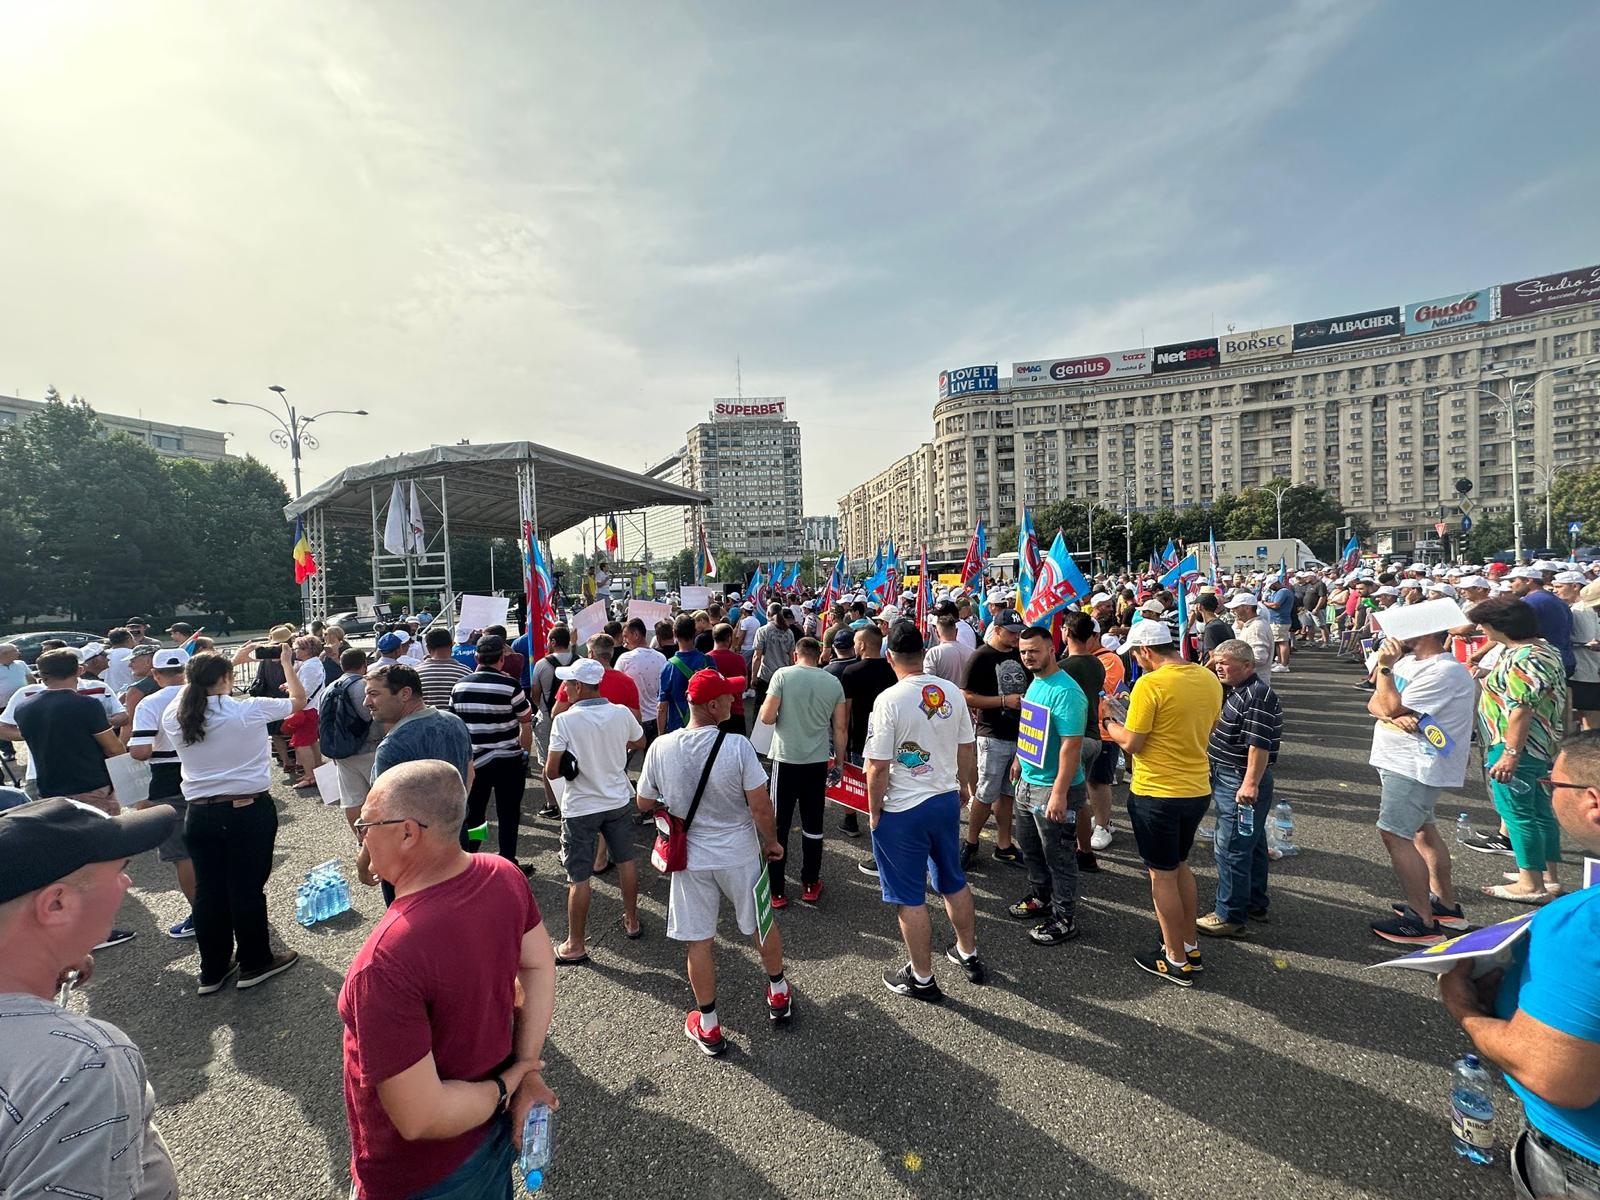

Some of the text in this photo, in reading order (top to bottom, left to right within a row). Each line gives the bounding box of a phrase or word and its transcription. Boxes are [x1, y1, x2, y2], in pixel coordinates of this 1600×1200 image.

[1515, 276, 1585, 297] Studio
[1415, 299, 1477, 322] Giusto
[1329, 314, 1395, 335] ALBACHER
[1226, 334, 1286, 354] BORSEC
[1121, 353, 1147, 361] tazz
[1157, 345, 1216, 365] NetBet
[950, 366, 997, 382] LOVE IT.
[1055, 360, 1104, 379] genius
[951, 378, 993, 394] LIVE IT.
[715, 402, 785, 416] SUPERBET
